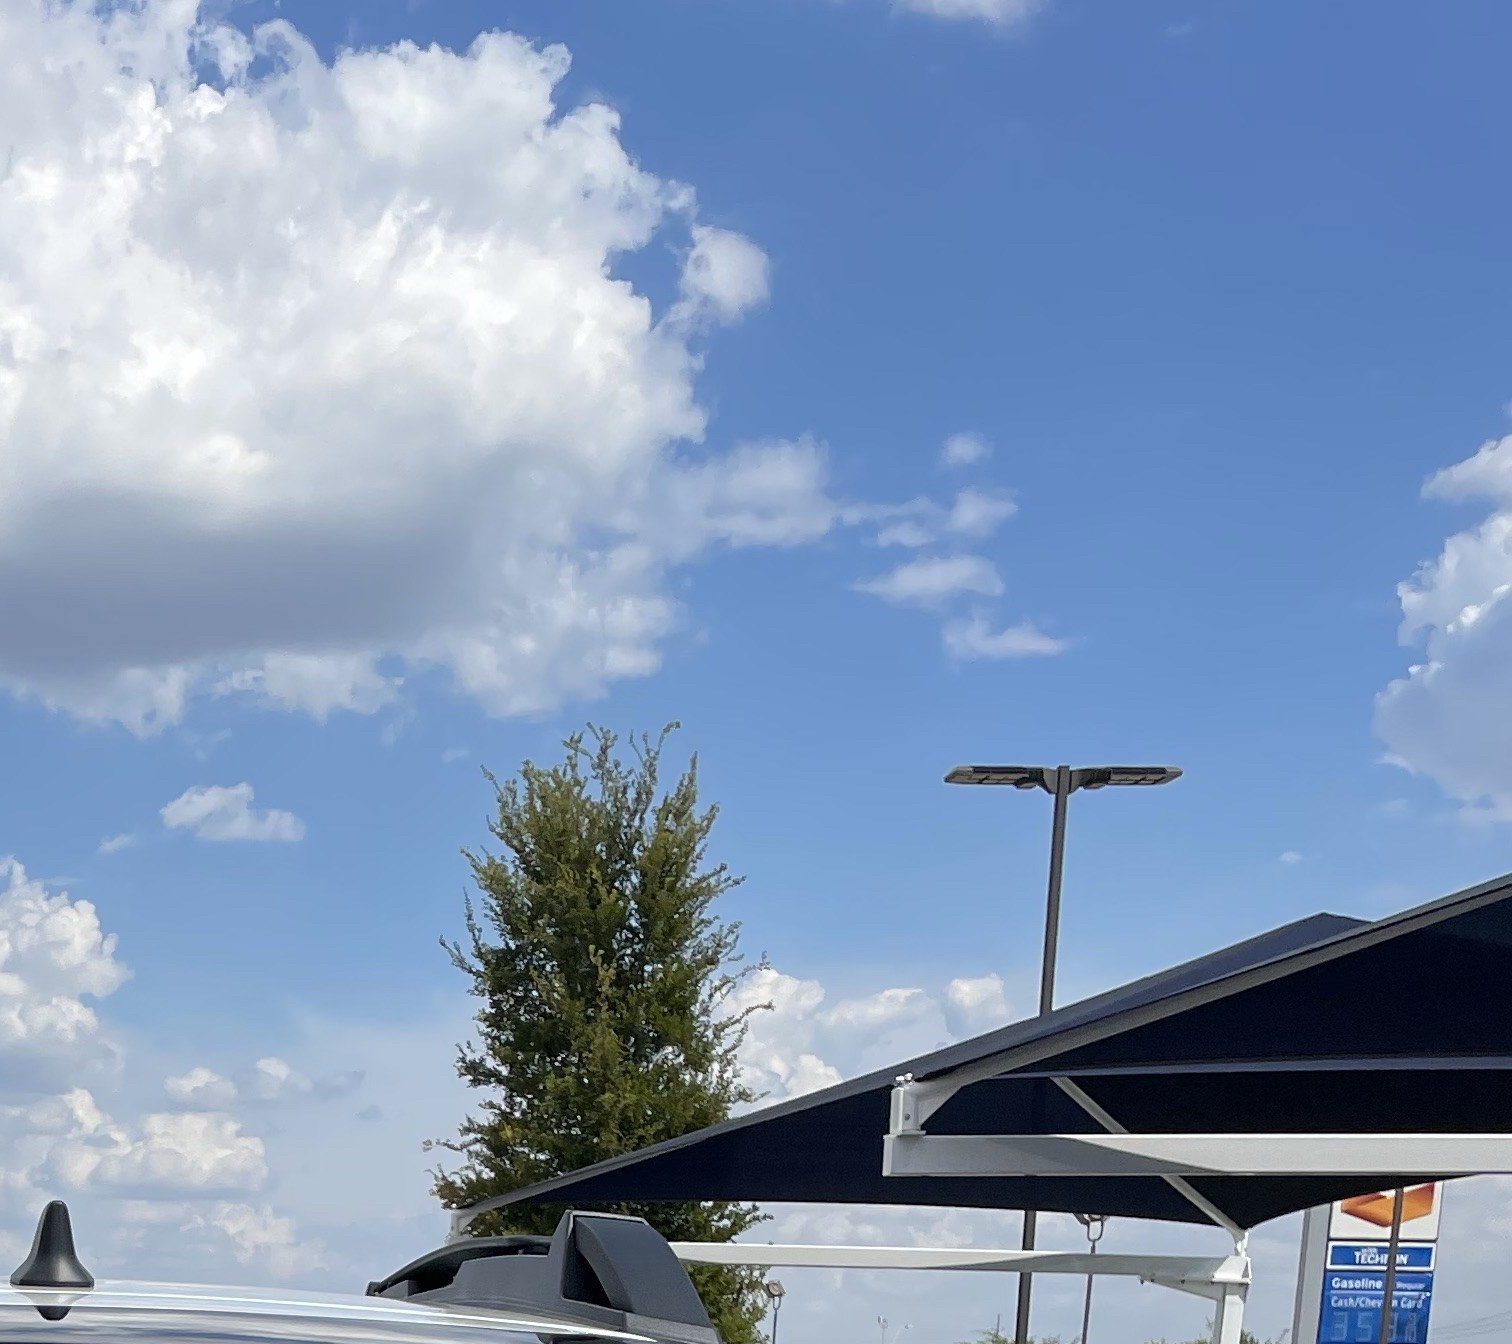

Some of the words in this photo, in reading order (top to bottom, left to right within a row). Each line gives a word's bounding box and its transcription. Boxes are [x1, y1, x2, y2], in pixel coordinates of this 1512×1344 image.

[1331, 1277, 1383, 1290] Gasoline
[1331, 1296, 1399, 1309] Cash/Chevn
[1400, 1295, 1424, 1309] Card
